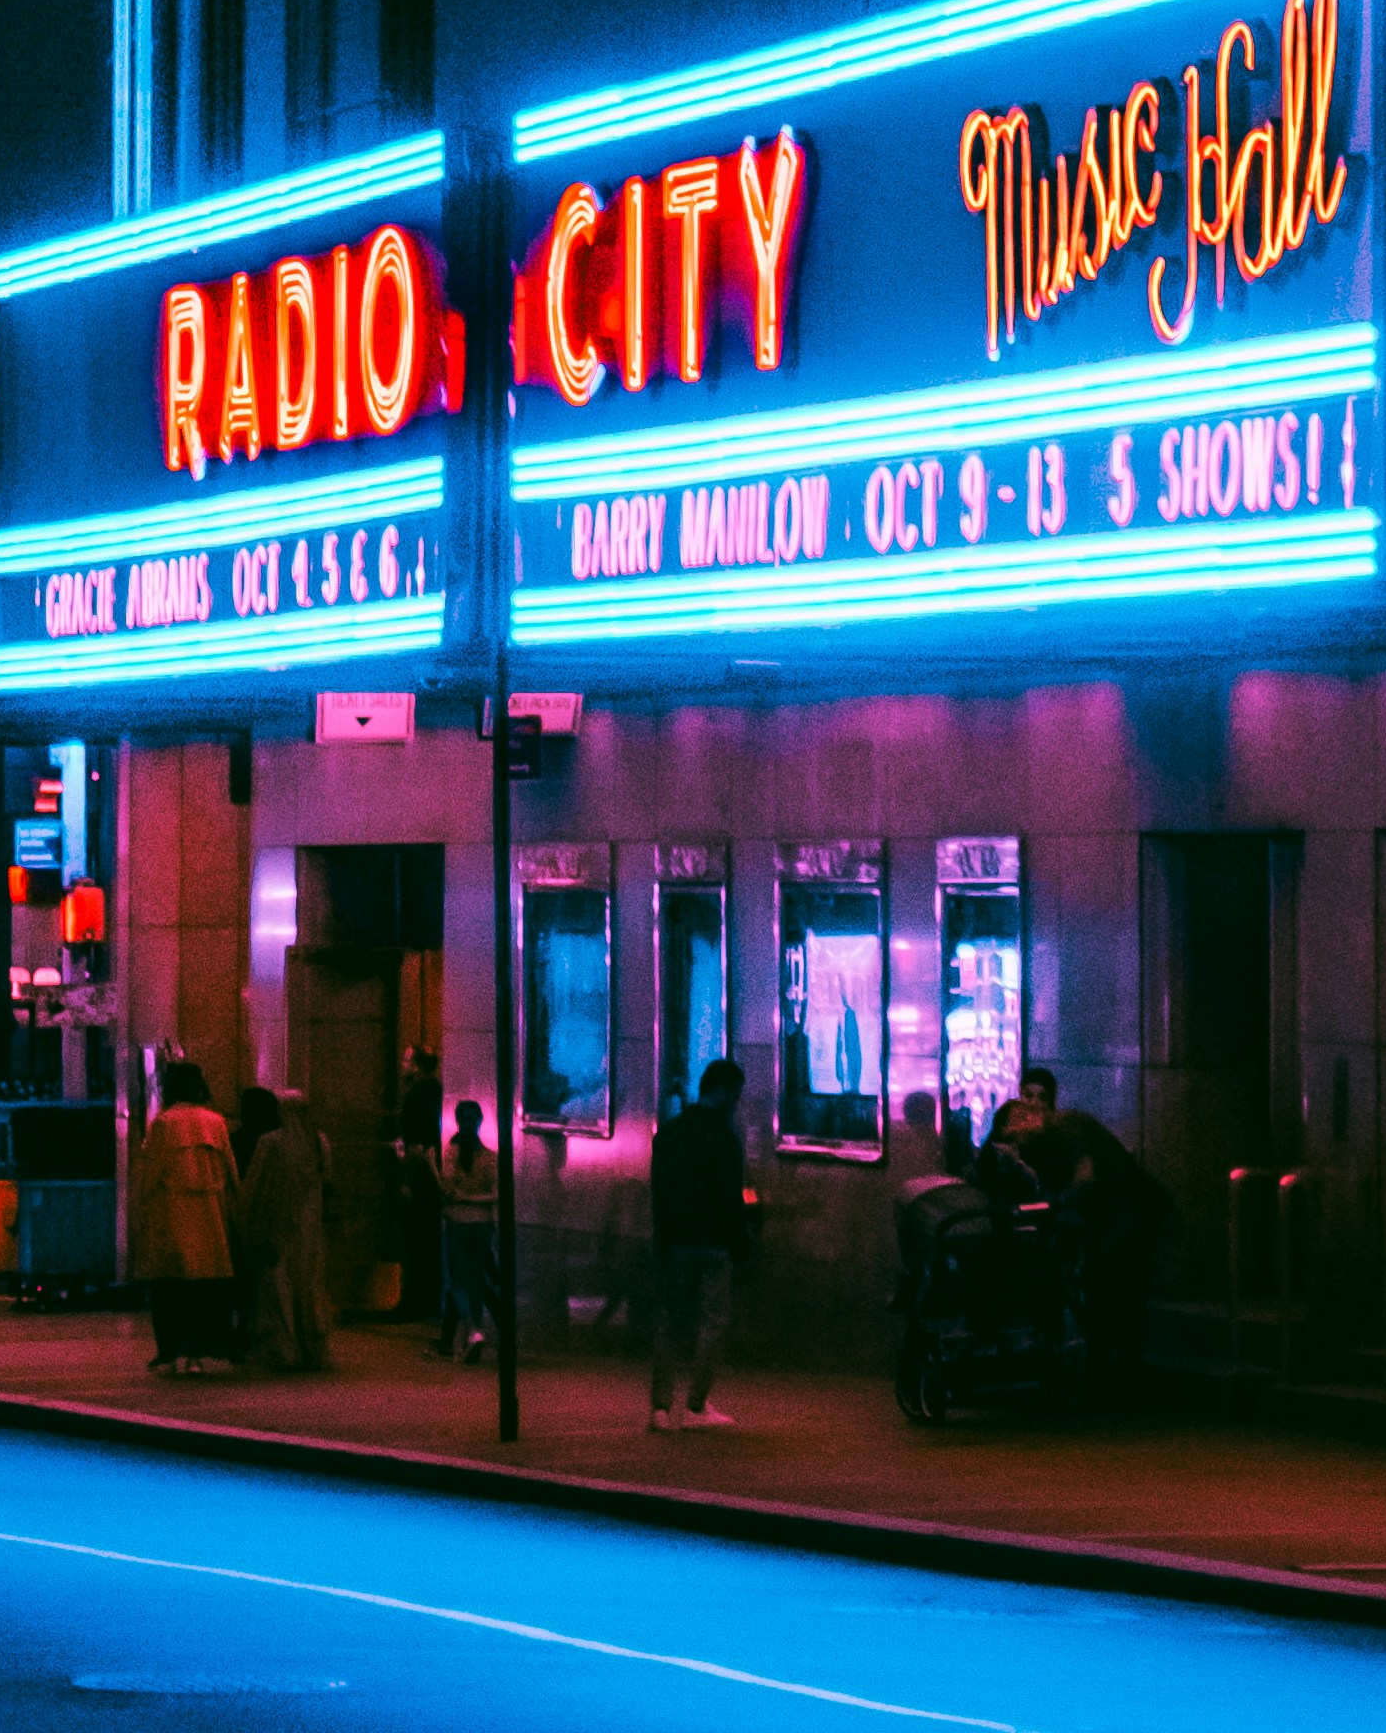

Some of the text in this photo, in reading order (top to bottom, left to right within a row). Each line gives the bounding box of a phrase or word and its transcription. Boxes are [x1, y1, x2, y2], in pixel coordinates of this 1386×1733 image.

[544, 124, 804, 406] CITY
[961, 81, 1162, 361] Music
[163, 224, 416, 481] RADIO
[45, 567, 117, 638] GRACIE
[126, 551, 213, 630] ABRAMS
[232, 540, 281, 618] OCT
[321, 530, 341, 606] 5
[378, 523, 400, 599] 6
[573, 492, 667, 581] BARRY
[680, 473, 830, 569] MANILOW
[864, 459, 945, 556] OCT
[1107, 431, 1138, 526] 5
[1156, 411, 1324, 523] SHOWS!
